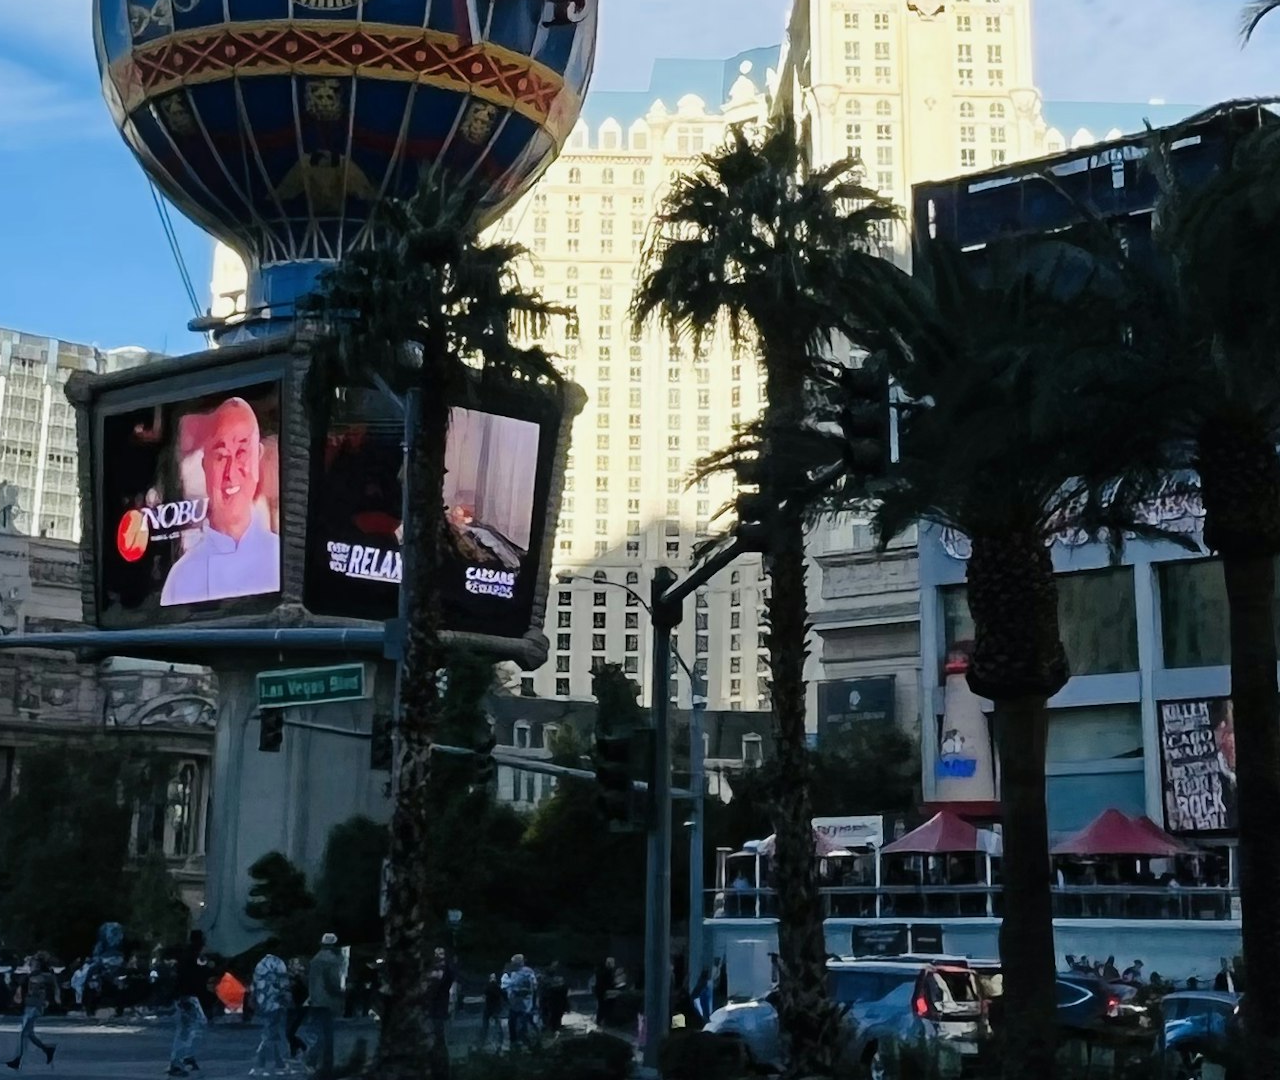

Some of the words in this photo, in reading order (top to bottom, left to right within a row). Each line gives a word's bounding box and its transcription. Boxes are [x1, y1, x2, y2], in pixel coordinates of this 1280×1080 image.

[140, 498, 210, 531] NOBU
[465, 566, 515, 585] CAESARS
[464, 580, 513, 599] REWARDS
[261, 683, 284, 698] Las
[287, 679, 326, 700] Vegas
